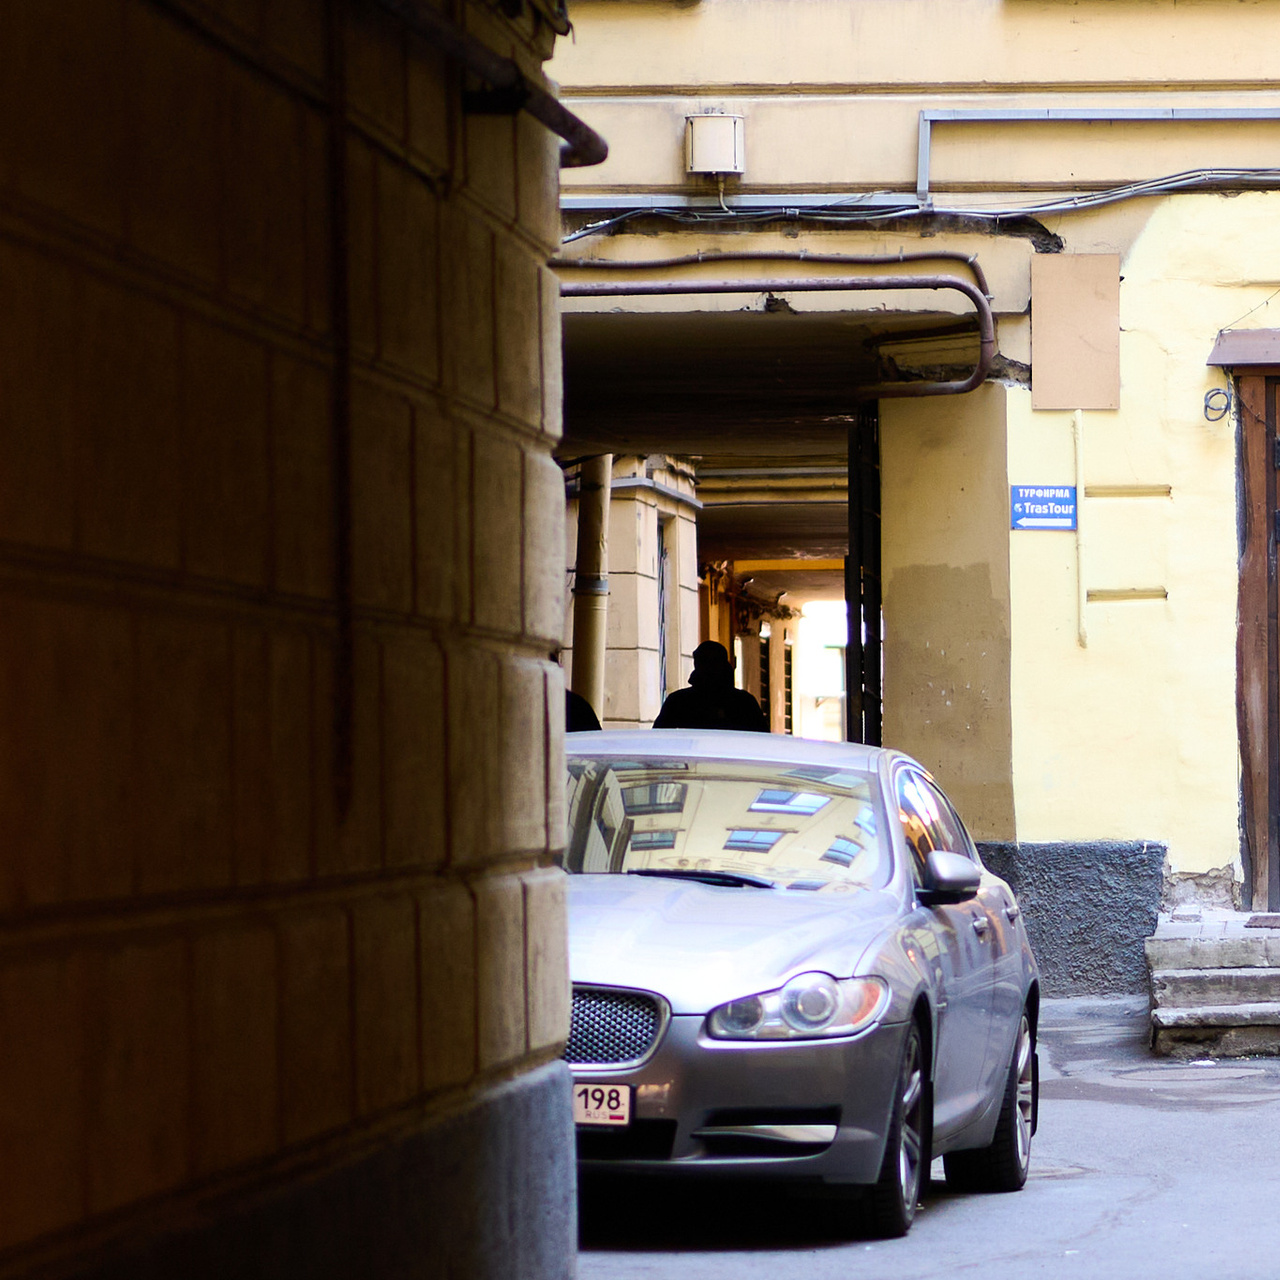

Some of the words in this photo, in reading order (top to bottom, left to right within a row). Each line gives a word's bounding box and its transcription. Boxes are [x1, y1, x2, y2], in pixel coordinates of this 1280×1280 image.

[1018, 488, 1070, 498] ТУРФИРМА
[1023, 502, 1074, 514] TrasTour
[577, 1088, 620, 1110] 198
[585, 1111, 607, 1119] RUS
